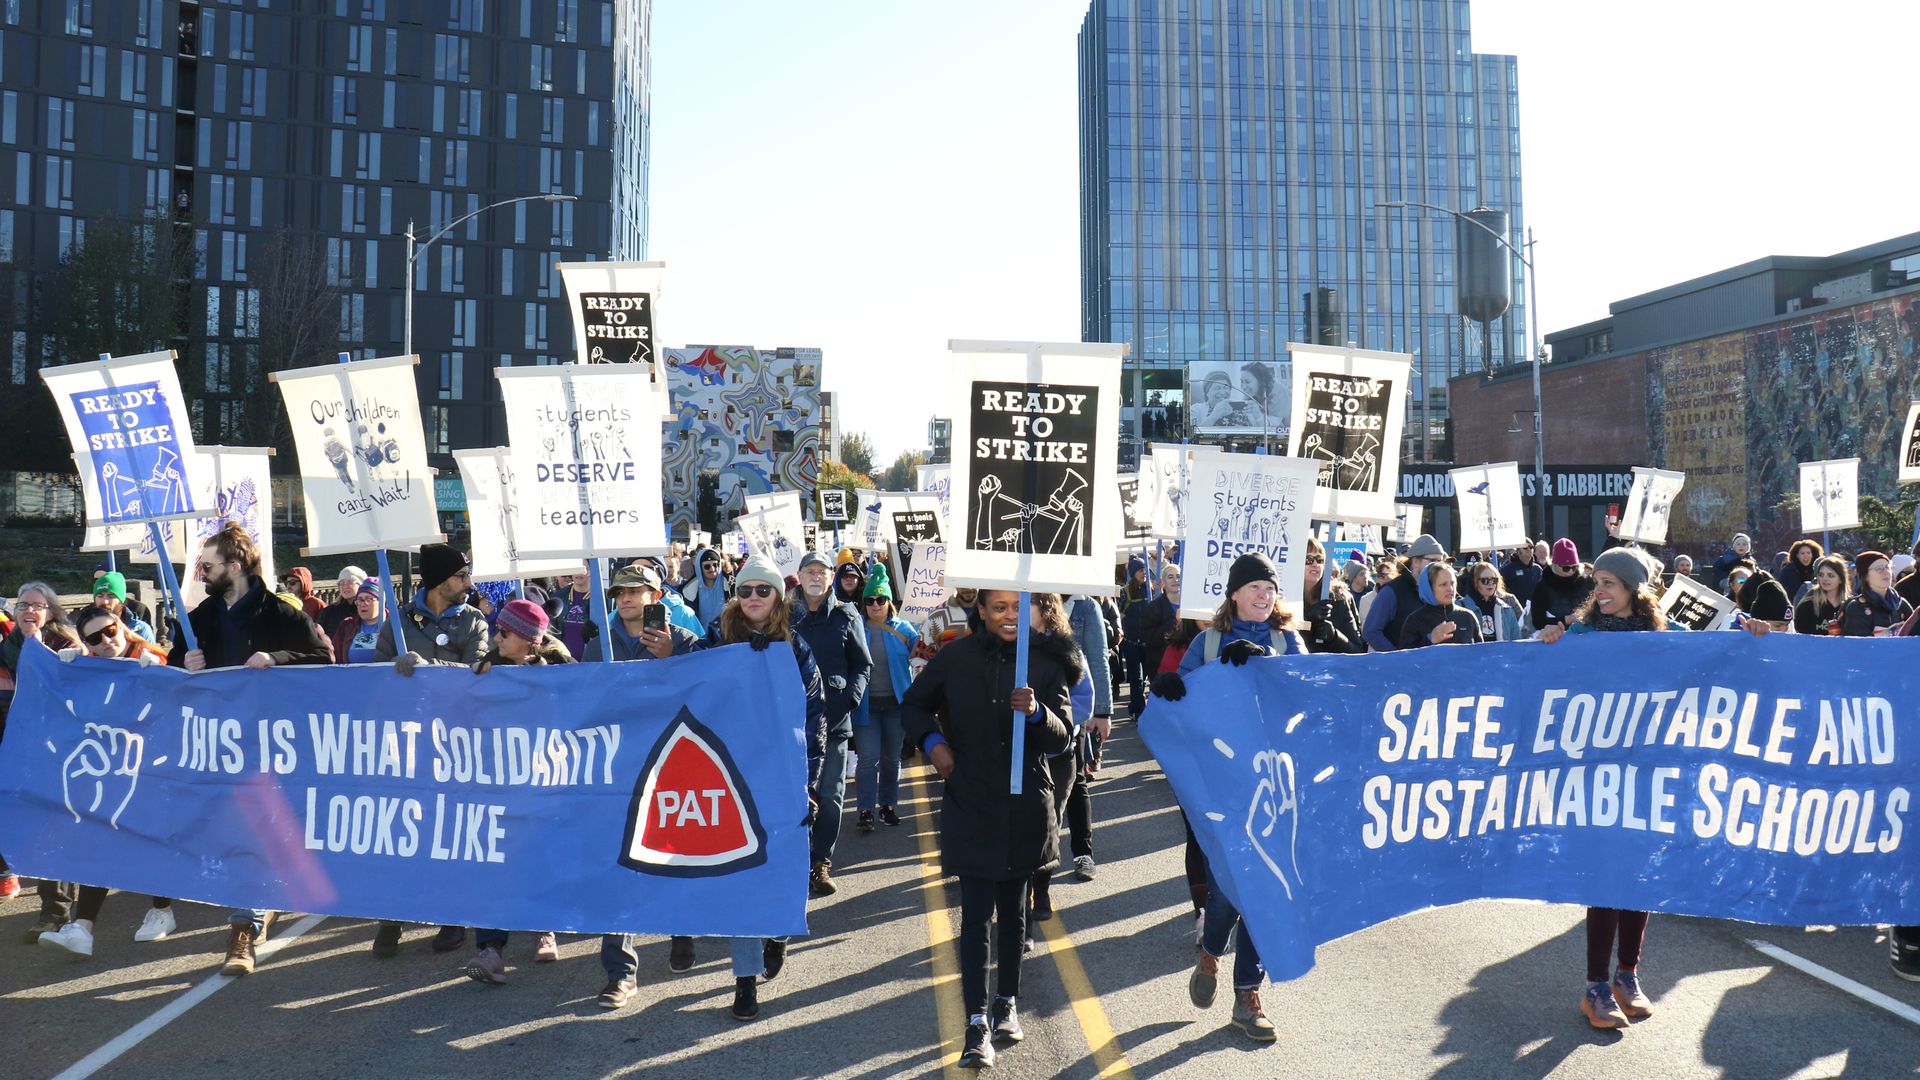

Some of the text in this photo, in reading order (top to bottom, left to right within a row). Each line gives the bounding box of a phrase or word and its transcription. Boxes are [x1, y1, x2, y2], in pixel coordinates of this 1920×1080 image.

[585, 297, 645, 310] READY
[604, 311, 627, 325] TO
[587, 325, 649, 339] STRIKE
[1312, 377, 1384, 398] READY
[80, 388, 156, 414] READY
[311, 397, 400, 425] Our children
[981, 390, 1087, 415] READY
[1332, 395, 1360, 413] TO
[108, 411, 139, 430] TO
[536, 403, 632, 427] students
[1012, 415, 1054, 438] TO
[1306, 408, 1382, 430] STRIKE
[91, 425, 172, 451] STRIKE
[976, 437, 1088, 463] STRIKE
[536, 462, 635, 484] DESERVE
[1215, 470, 1301, 497] DIVERSE
[1542, 473, 1553, 497] &
[1557, 473, 1632, 497] DABBLERS
[1213, 489, 1297, 513] students
[540, 504, 639, 525] teachers
[911, 587, 944, 600] Staff
[1378, 686, 1895, 767] SAFE, EQUITABLE AND
[177, 706, 621, 787] THIS IS WHAT SOLIDARITY
[656, 789, 726, 829] PAT
[1362, 763, 1910, 857] SUSTAINABLE SCHOOLS
[304, 787, 506, 864] LOOKS LIKE
